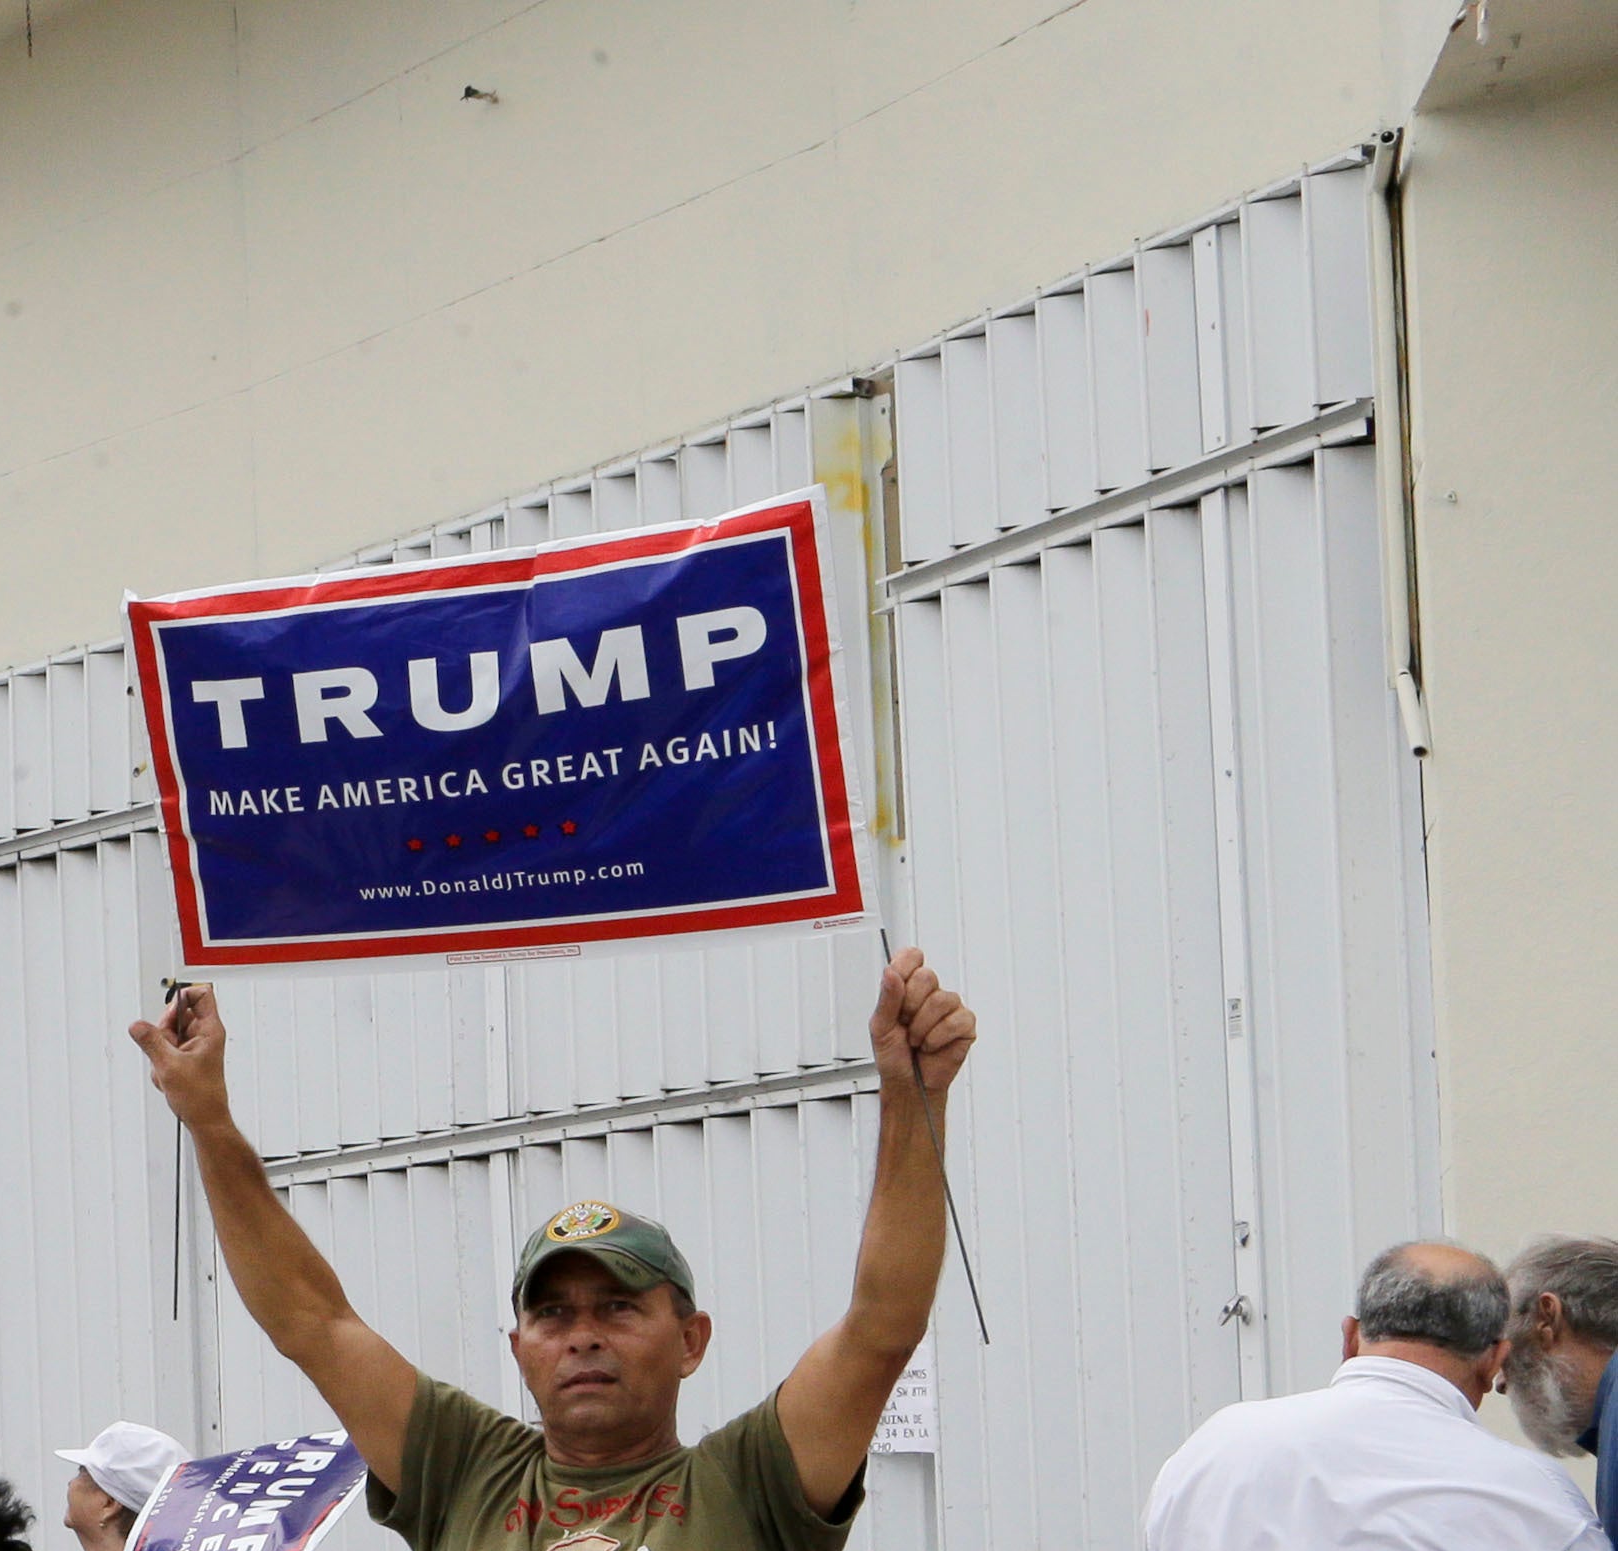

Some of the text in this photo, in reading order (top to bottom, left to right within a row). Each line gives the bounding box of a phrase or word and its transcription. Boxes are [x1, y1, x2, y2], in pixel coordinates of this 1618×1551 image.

[191, 605, 768, 749] TRUMP
[209, 720, 777, 816] MAKE AMERICA GREAT AGAIN!
[359, 861, 645, 900] www.DonaldJTrump.com
